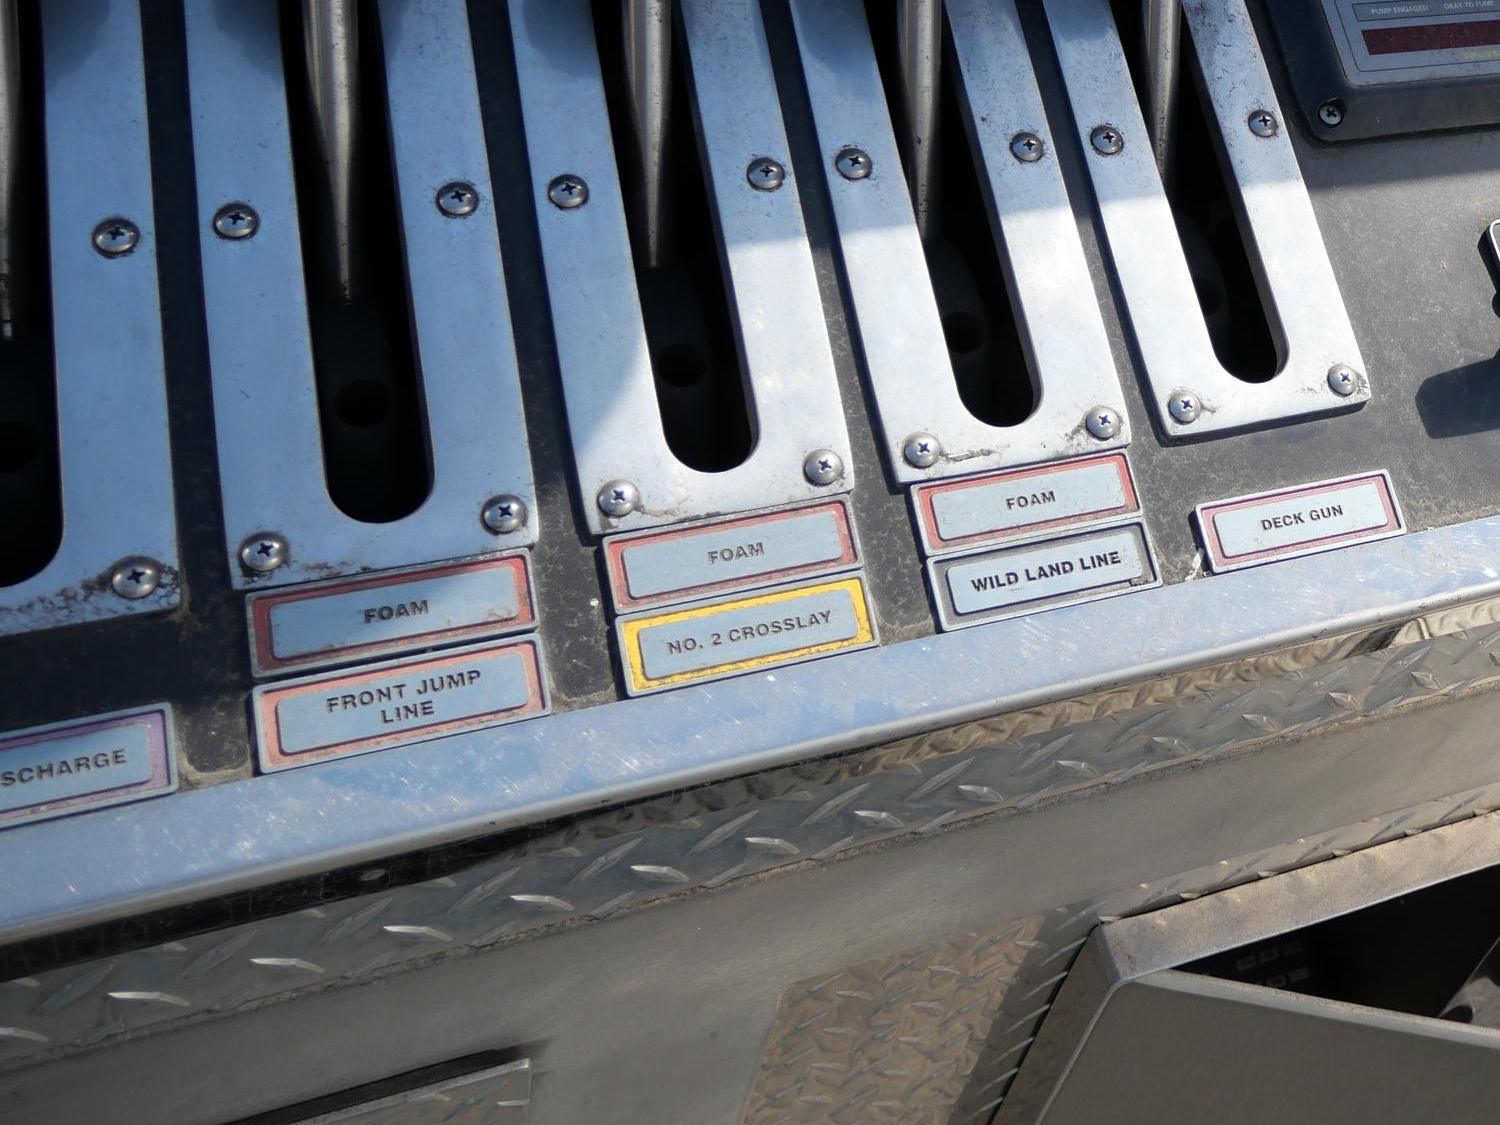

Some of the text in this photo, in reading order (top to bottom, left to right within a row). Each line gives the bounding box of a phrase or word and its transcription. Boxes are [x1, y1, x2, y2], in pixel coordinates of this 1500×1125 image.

[1005, 492, 1056, 511] FOAM
[1261, 504, 1344, 531] DECK GUN
[708, 542, 765, 565] FOAM
[971, 551, 1121, 592] WILD LAND LINE
[364, 600, 429, 624] FOAM
[667, 610, 833, 656] NO. 2 CROSSLAY
[327, 670, 482, 713] FRONT JUMP
[381, 700, 435, 724] LINE
